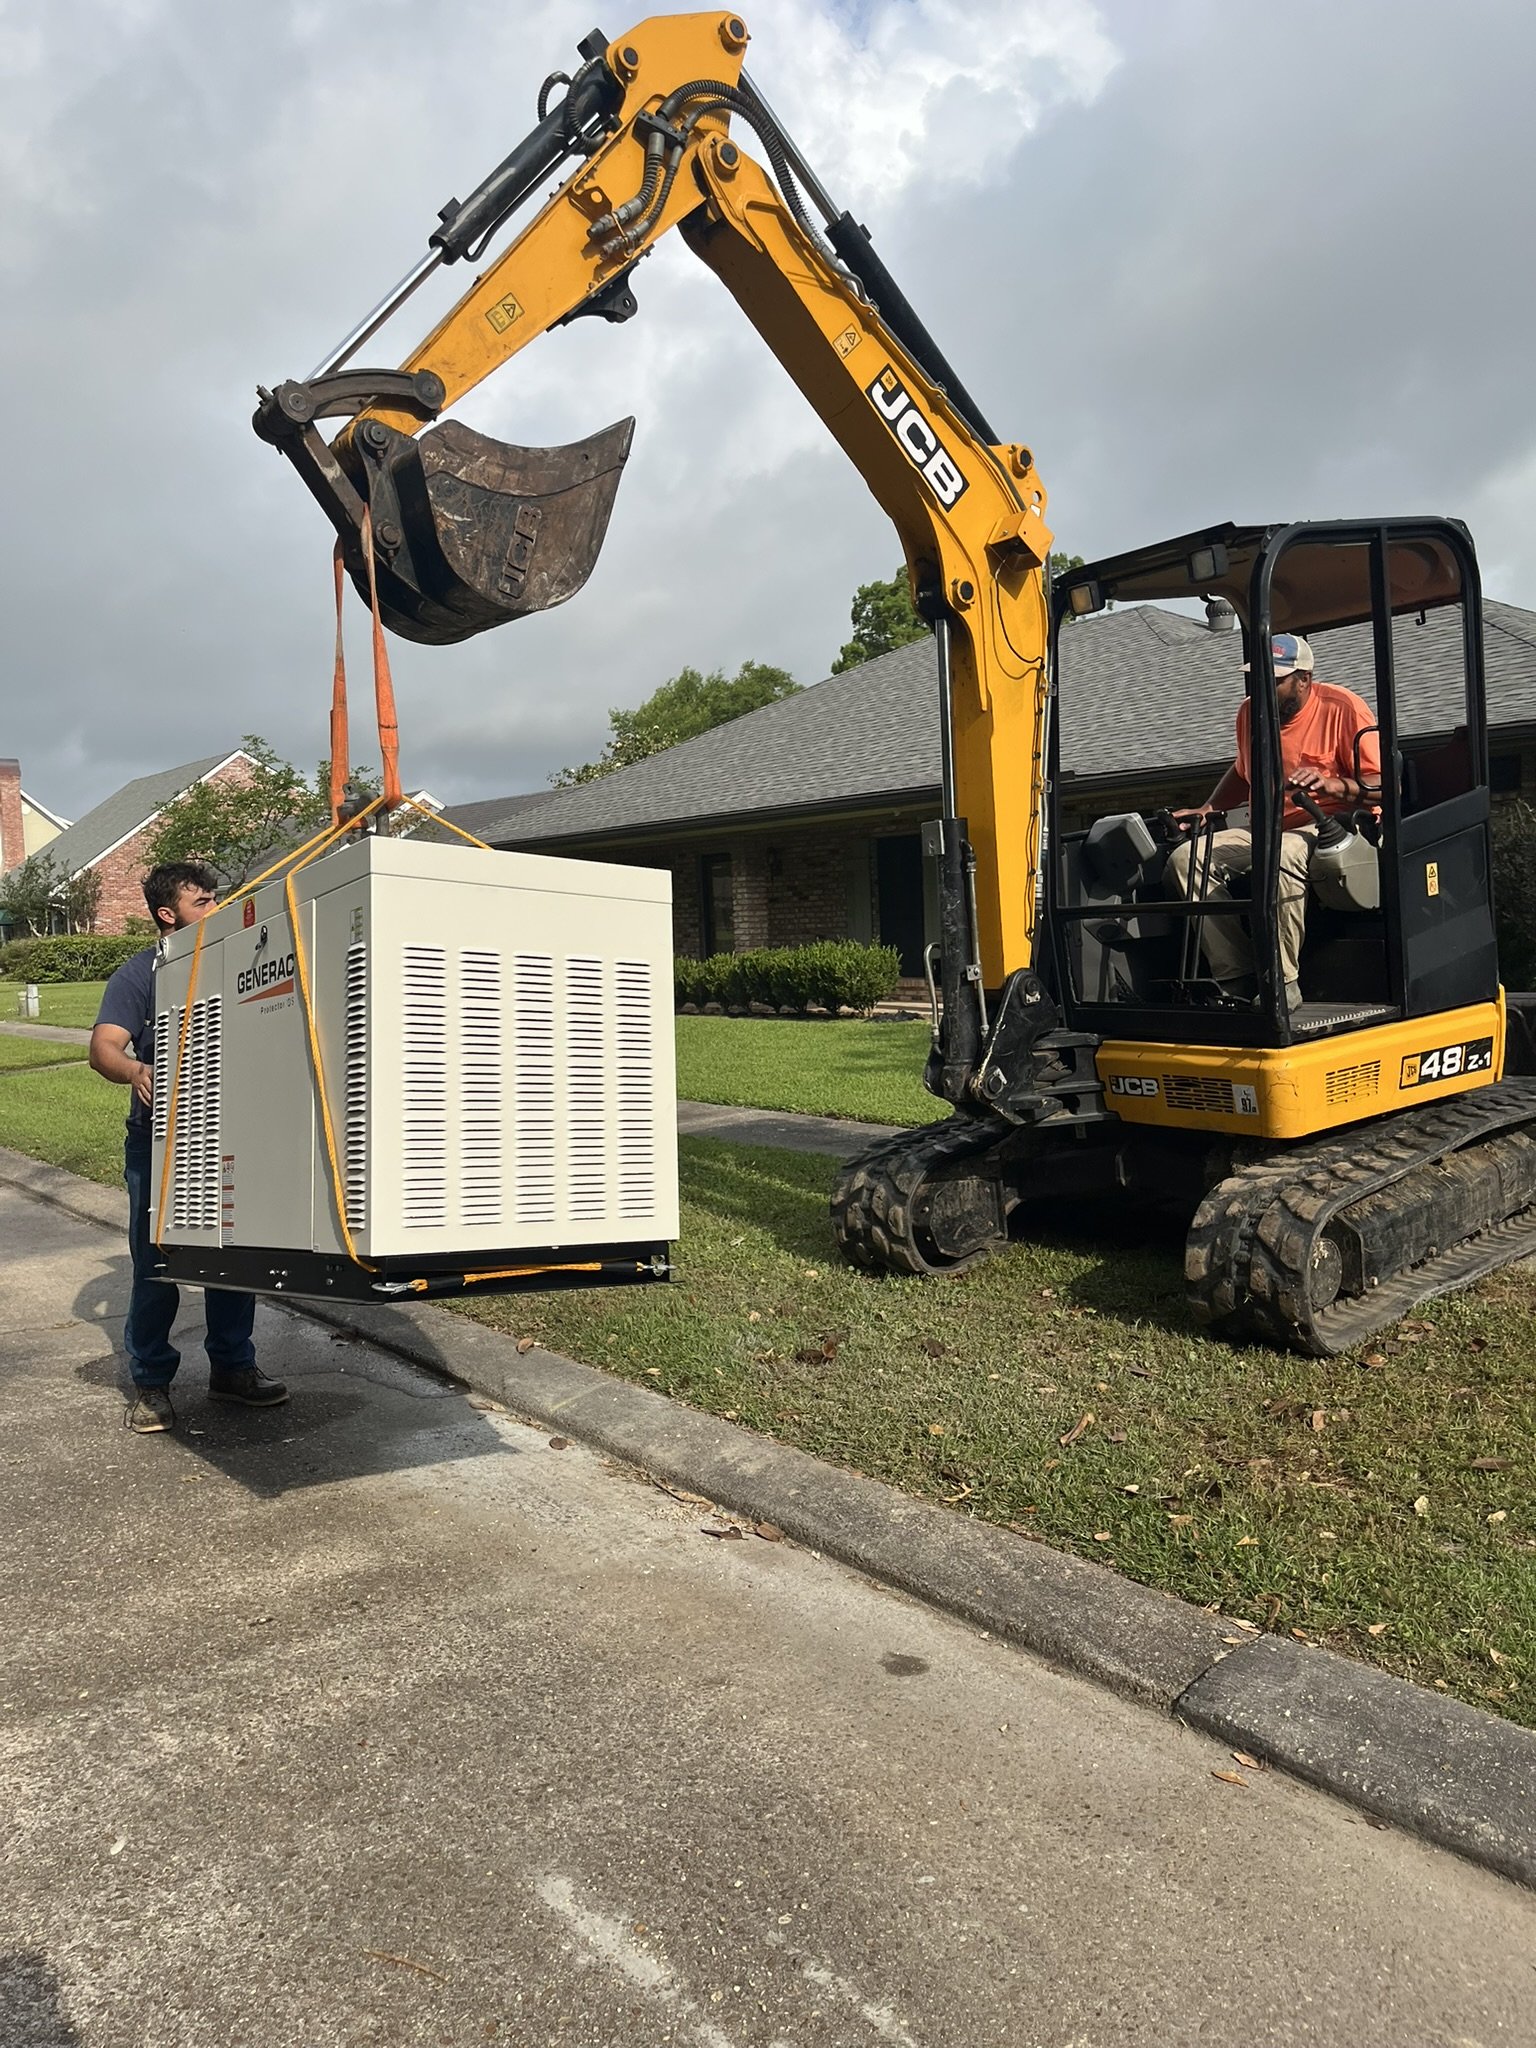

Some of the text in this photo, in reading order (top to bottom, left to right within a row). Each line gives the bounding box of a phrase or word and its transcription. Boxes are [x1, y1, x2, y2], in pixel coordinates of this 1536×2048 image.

[871, 382, 963, 505] JCB
[498, 504, 542, 599] JCB
[237, 953, 294, 994] GENERAC
[260, 1001, 285, 1015] Protector
[1421, 1046, 1462, 1078] 48
[1112, 1077, 1159, 1096] JCB
